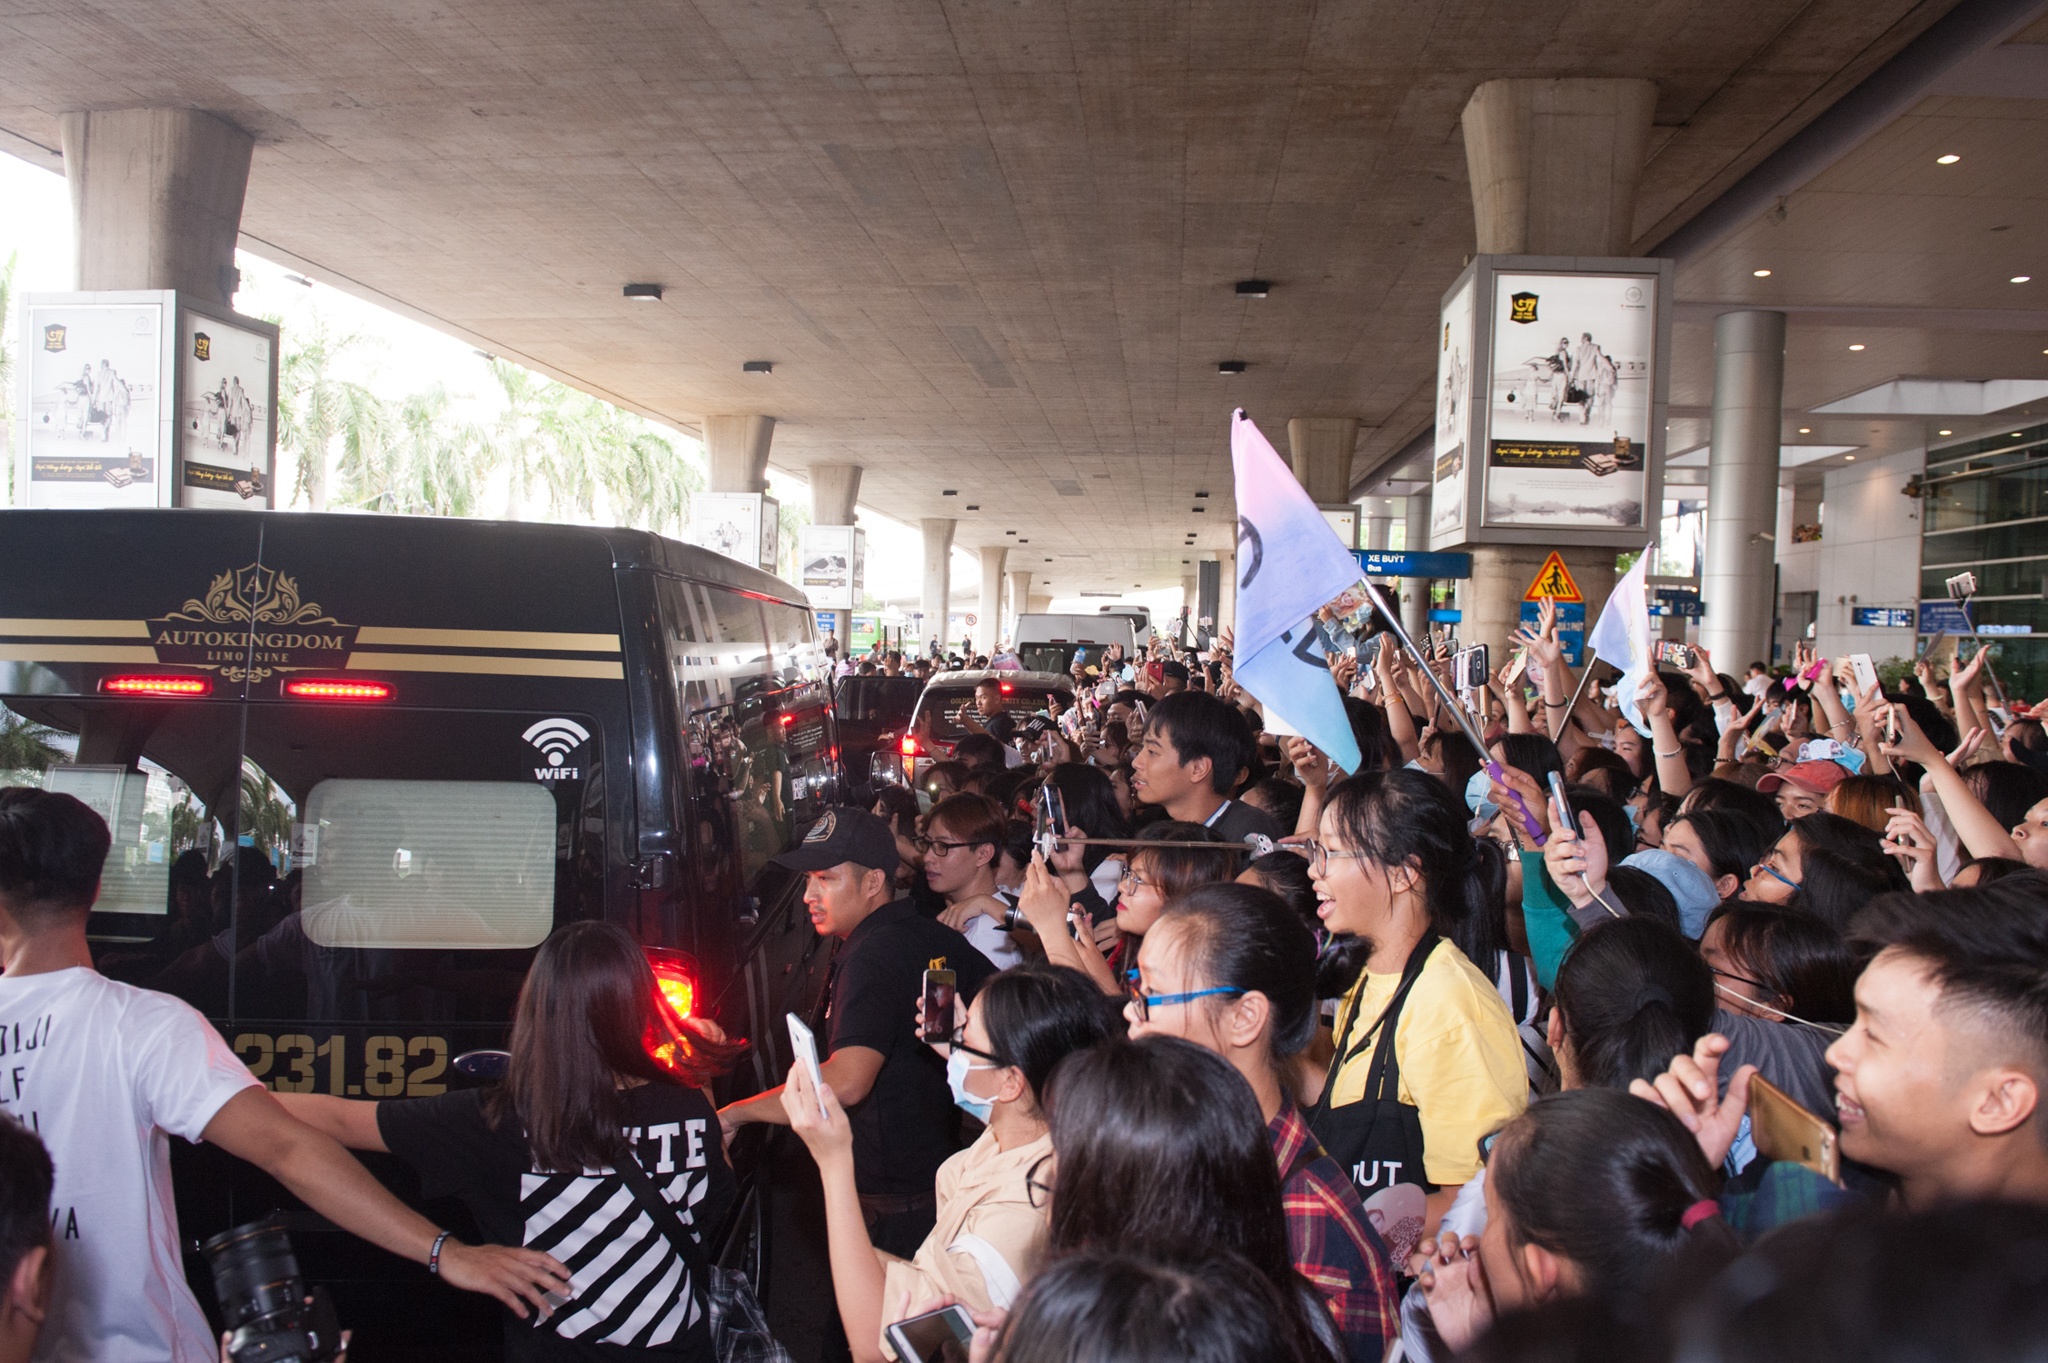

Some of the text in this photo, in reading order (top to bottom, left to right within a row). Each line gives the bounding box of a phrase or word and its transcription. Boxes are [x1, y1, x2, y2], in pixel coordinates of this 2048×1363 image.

[1368, 553, 1406, 564] XE BUÝT
[1367, 564, 1382, 572] Bus
[1680, 602, 1696, 616] 12
[155, 630, 344, 650] AUTOKINGDOM
[534, 767, 578, 780] WiFi
[234, 1033, 448, 1097] 231.82
